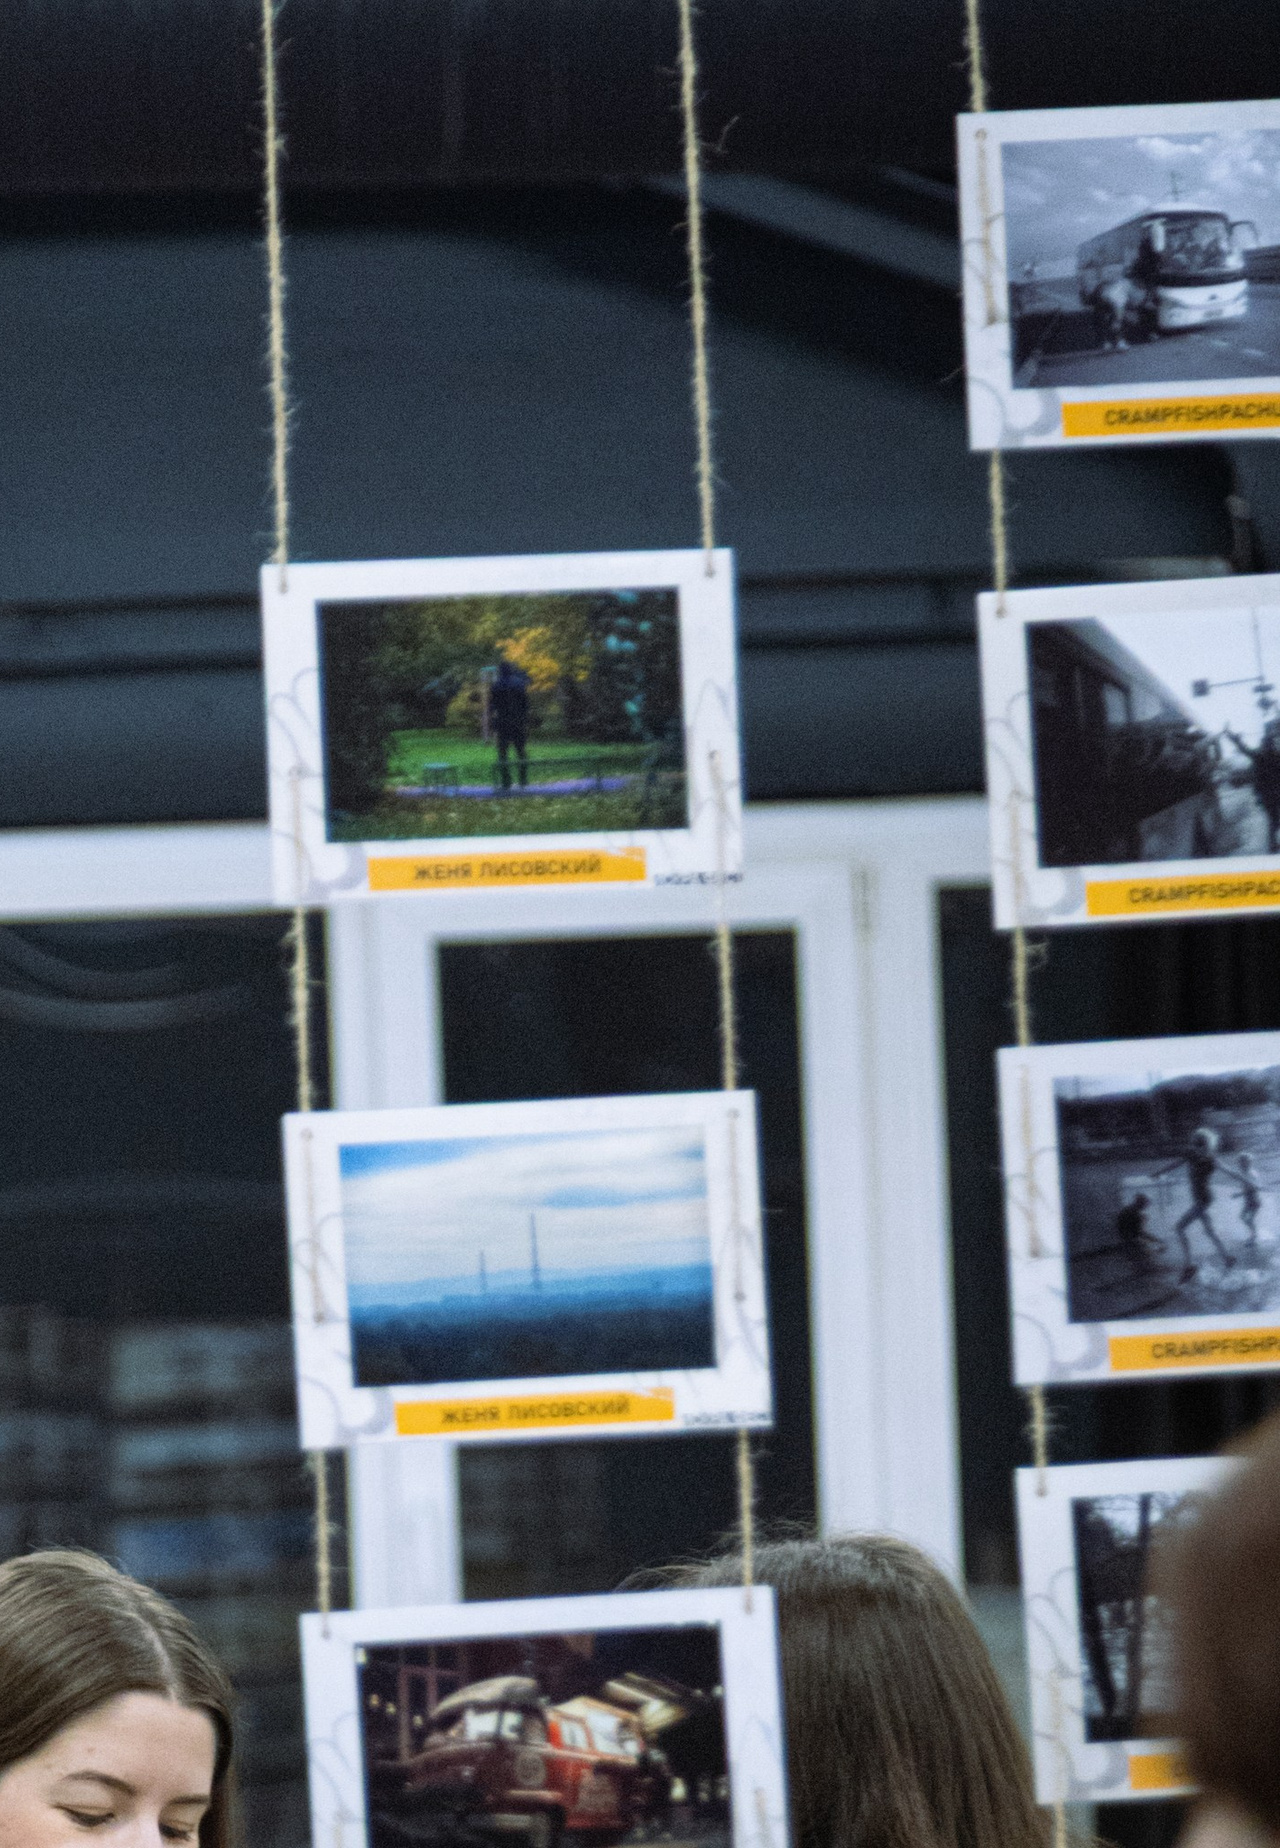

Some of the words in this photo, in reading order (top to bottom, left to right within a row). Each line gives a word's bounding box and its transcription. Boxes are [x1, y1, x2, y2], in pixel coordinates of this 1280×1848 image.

[414, 861, 472, 880] ЖЕНЯ
[478, 853, 602, 877] ЛИСОВСКИЙ
[441, 1405, 500, 1424] ЖЕНЯ
